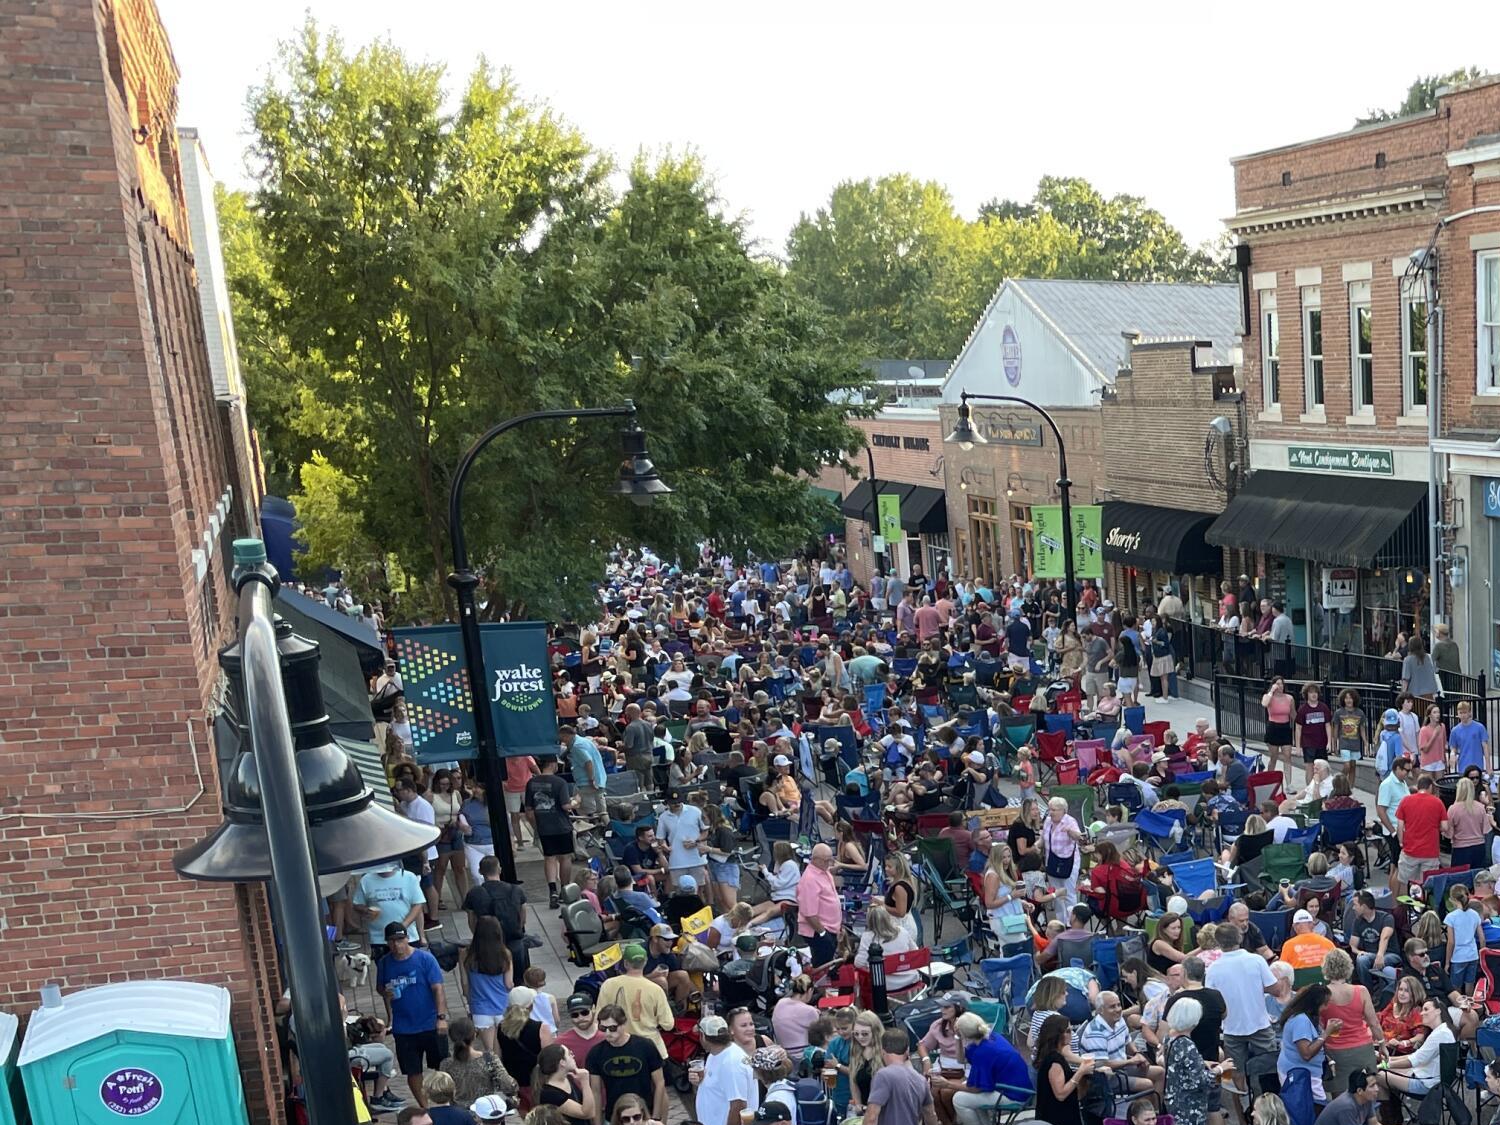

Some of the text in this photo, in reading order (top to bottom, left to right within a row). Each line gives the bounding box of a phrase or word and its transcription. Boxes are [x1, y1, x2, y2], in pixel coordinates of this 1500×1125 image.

[1105, 526, 1141, 554] Shorty's
[494, 663, 543, 680] wake
[491, 678, 546, 702] forest
[501, 697, 544, 713] DOWNTOWN
[106, 1071, 154, 1090] A Fresh
